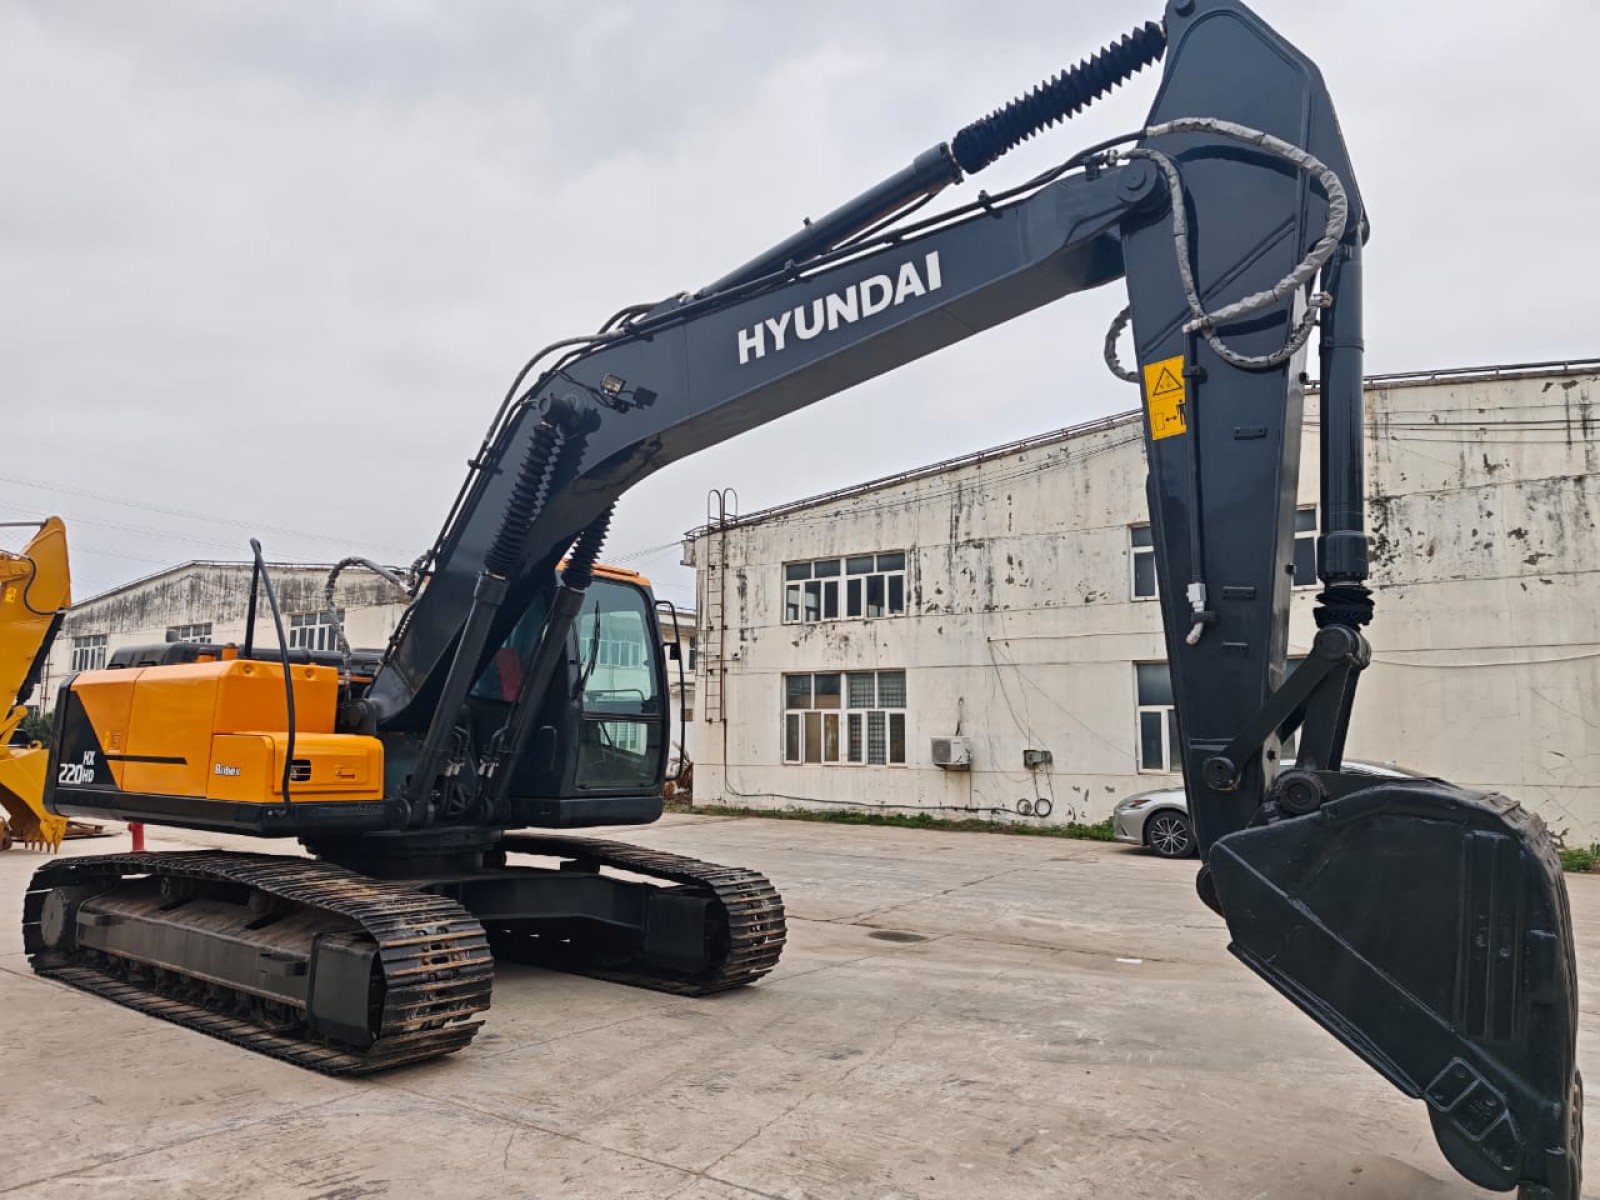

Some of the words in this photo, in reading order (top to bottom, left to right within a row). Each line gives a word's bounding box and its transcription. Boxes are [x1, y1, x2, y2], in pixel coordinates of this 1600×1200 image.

[738, 251, 942, 365] HYUNDAI
[59, 763, 82, 784] 220
[82, 769, 95, 783] HD
